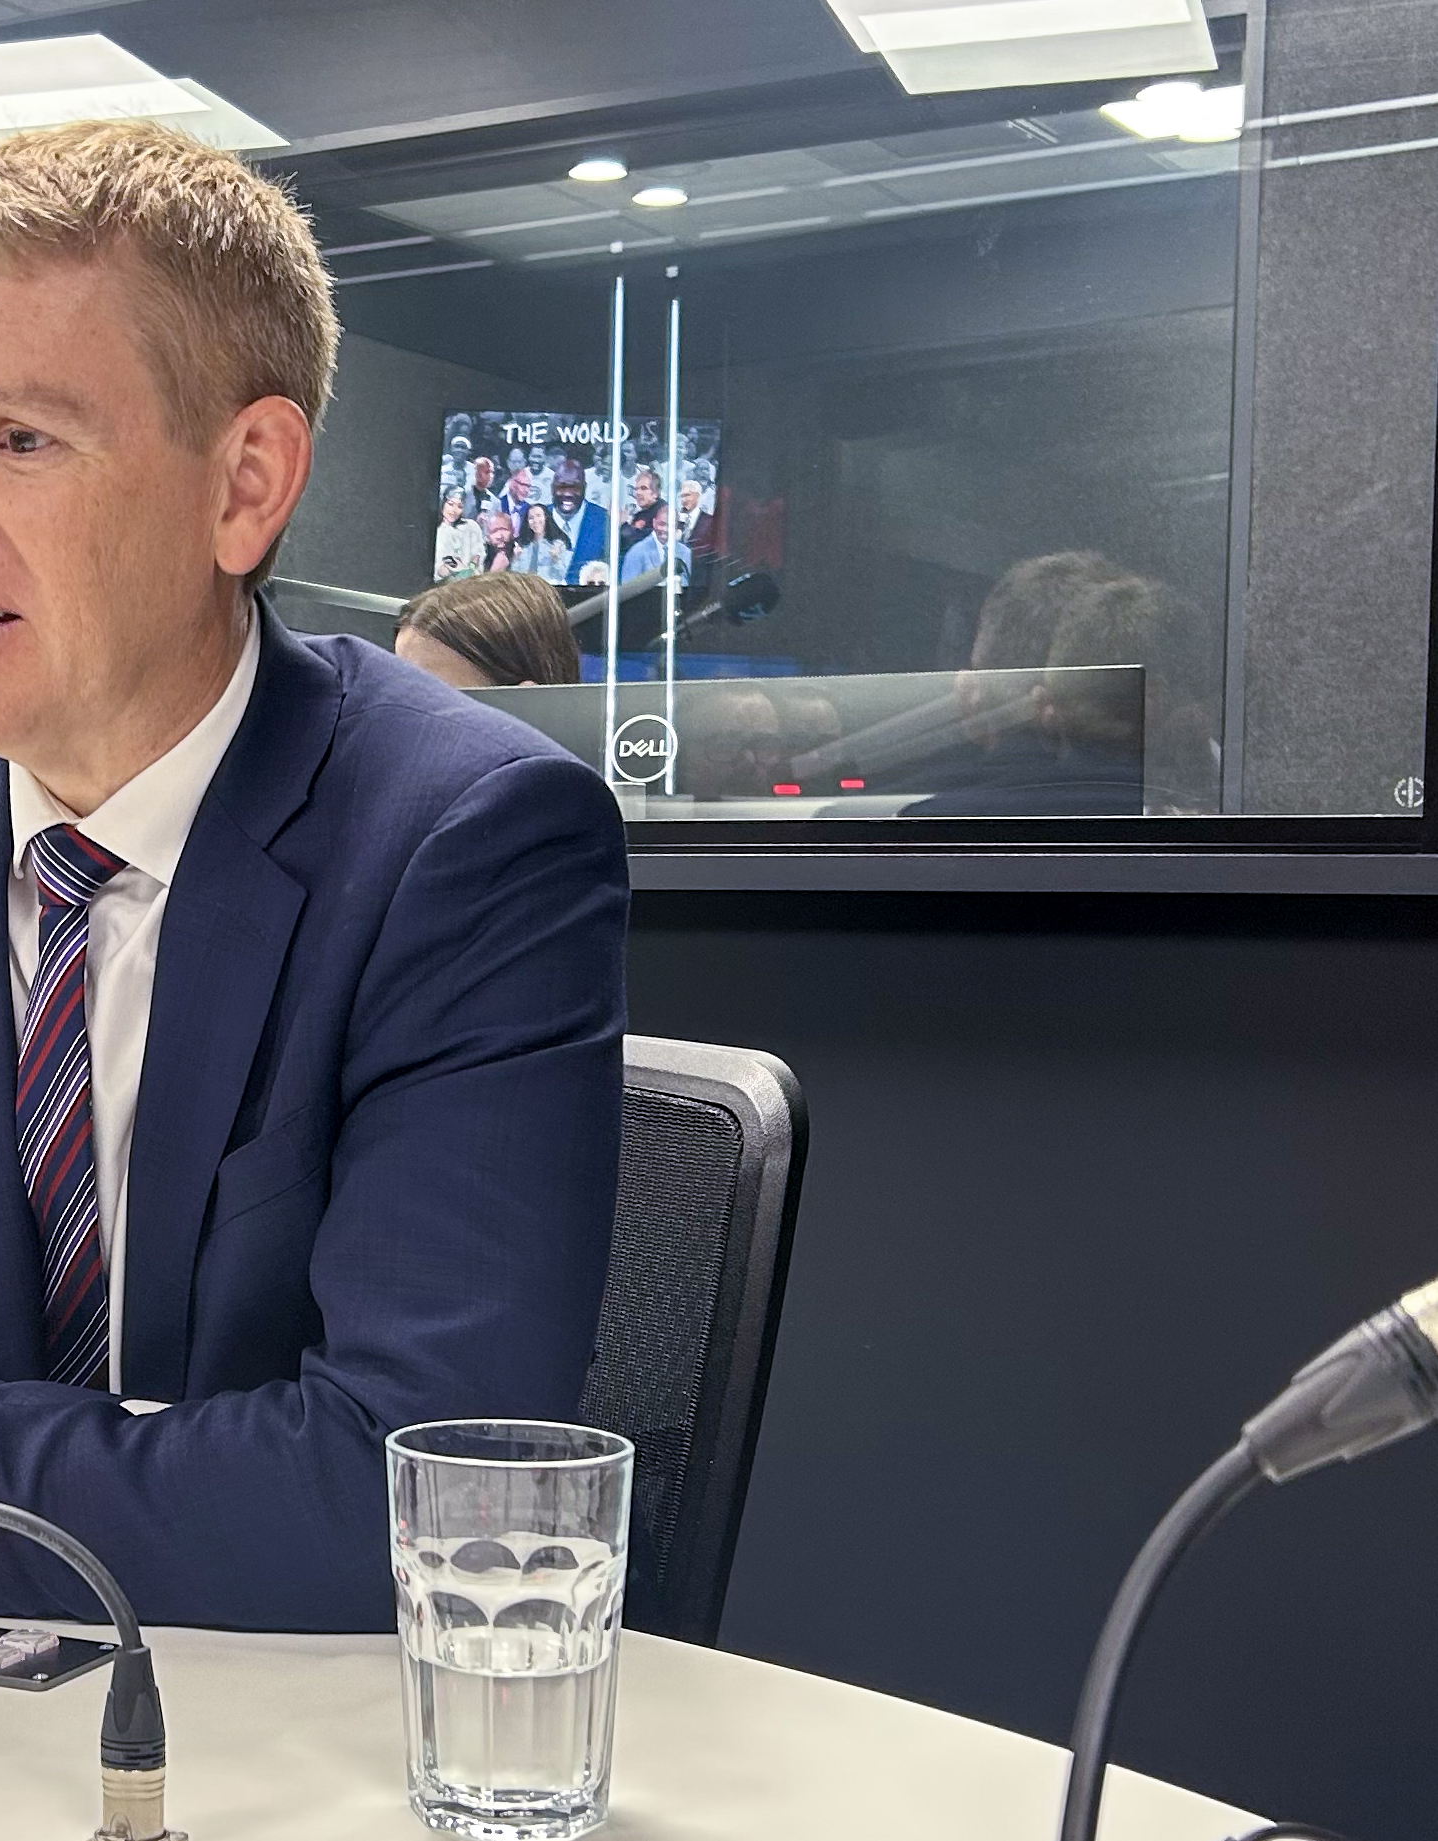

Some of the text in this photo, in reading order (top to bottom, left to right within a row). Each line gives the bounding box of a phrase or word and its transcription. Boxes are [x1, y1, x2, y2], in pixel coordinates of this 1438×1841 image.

[502, 421, 548, 445] THE
[556, 420, 630, 445] WORLD
[619, 739, 671, 758] DELL
